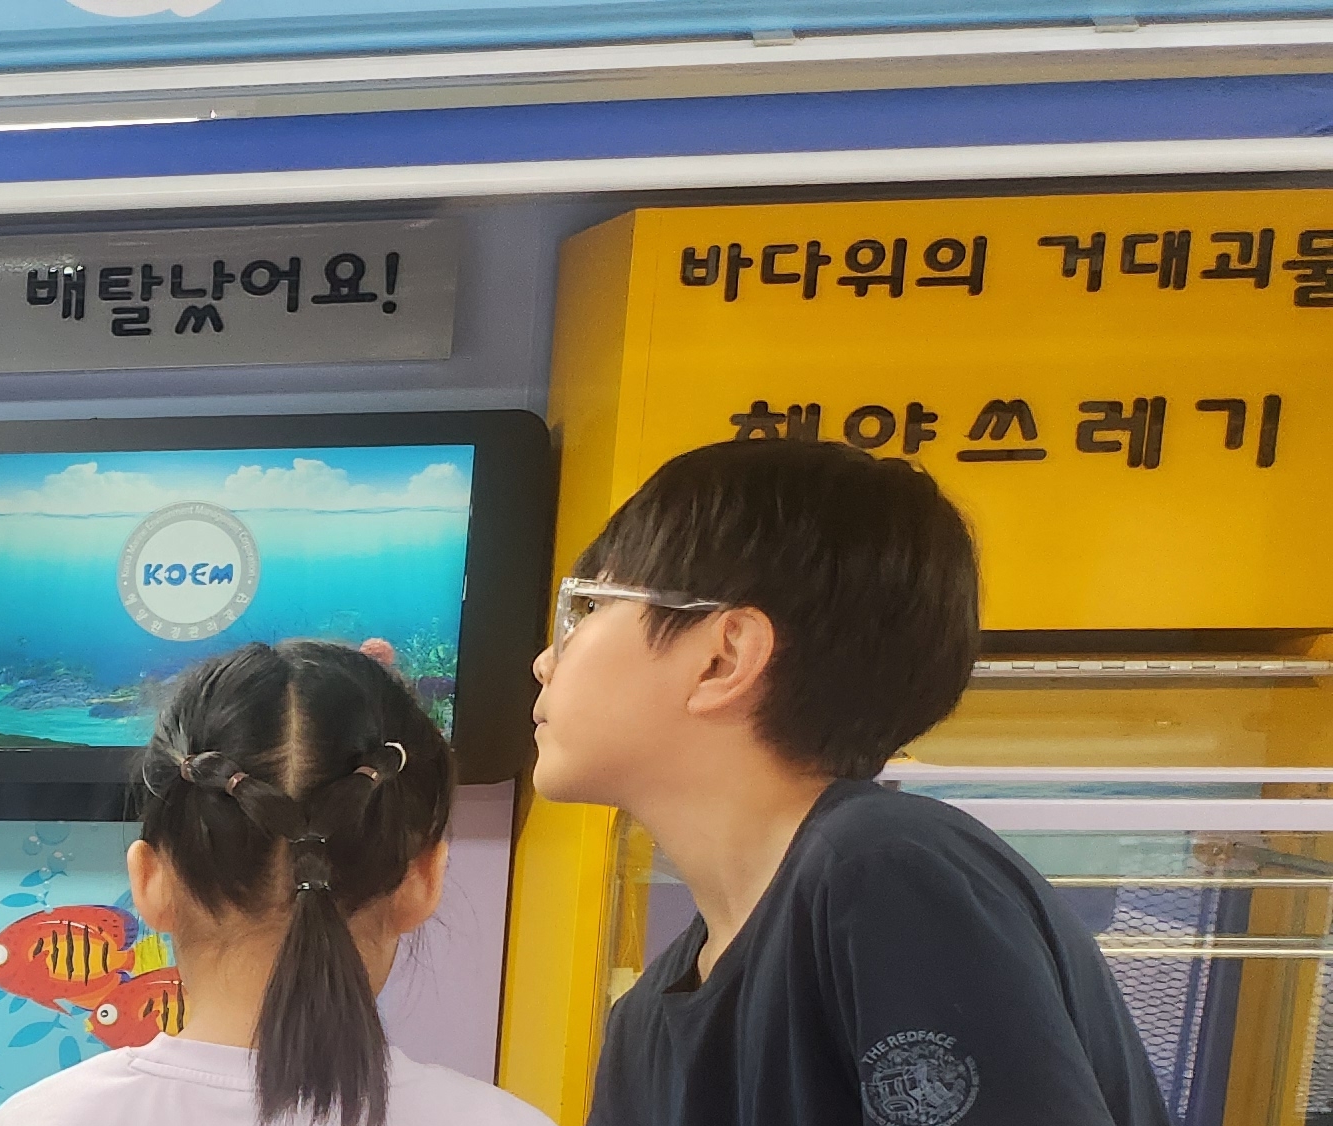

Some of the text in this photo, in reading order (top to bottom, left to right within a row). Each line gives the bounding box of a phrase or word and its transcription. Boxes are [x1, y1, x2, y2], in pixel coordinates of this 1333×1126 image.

[25, 251, 402, 336] 배탈났어요!
[679, 228, 1333, 308] 바다위의 거대괴물
[142, 563, 234, 587] KOEM
[861, 1039, 889, 1065] THE
